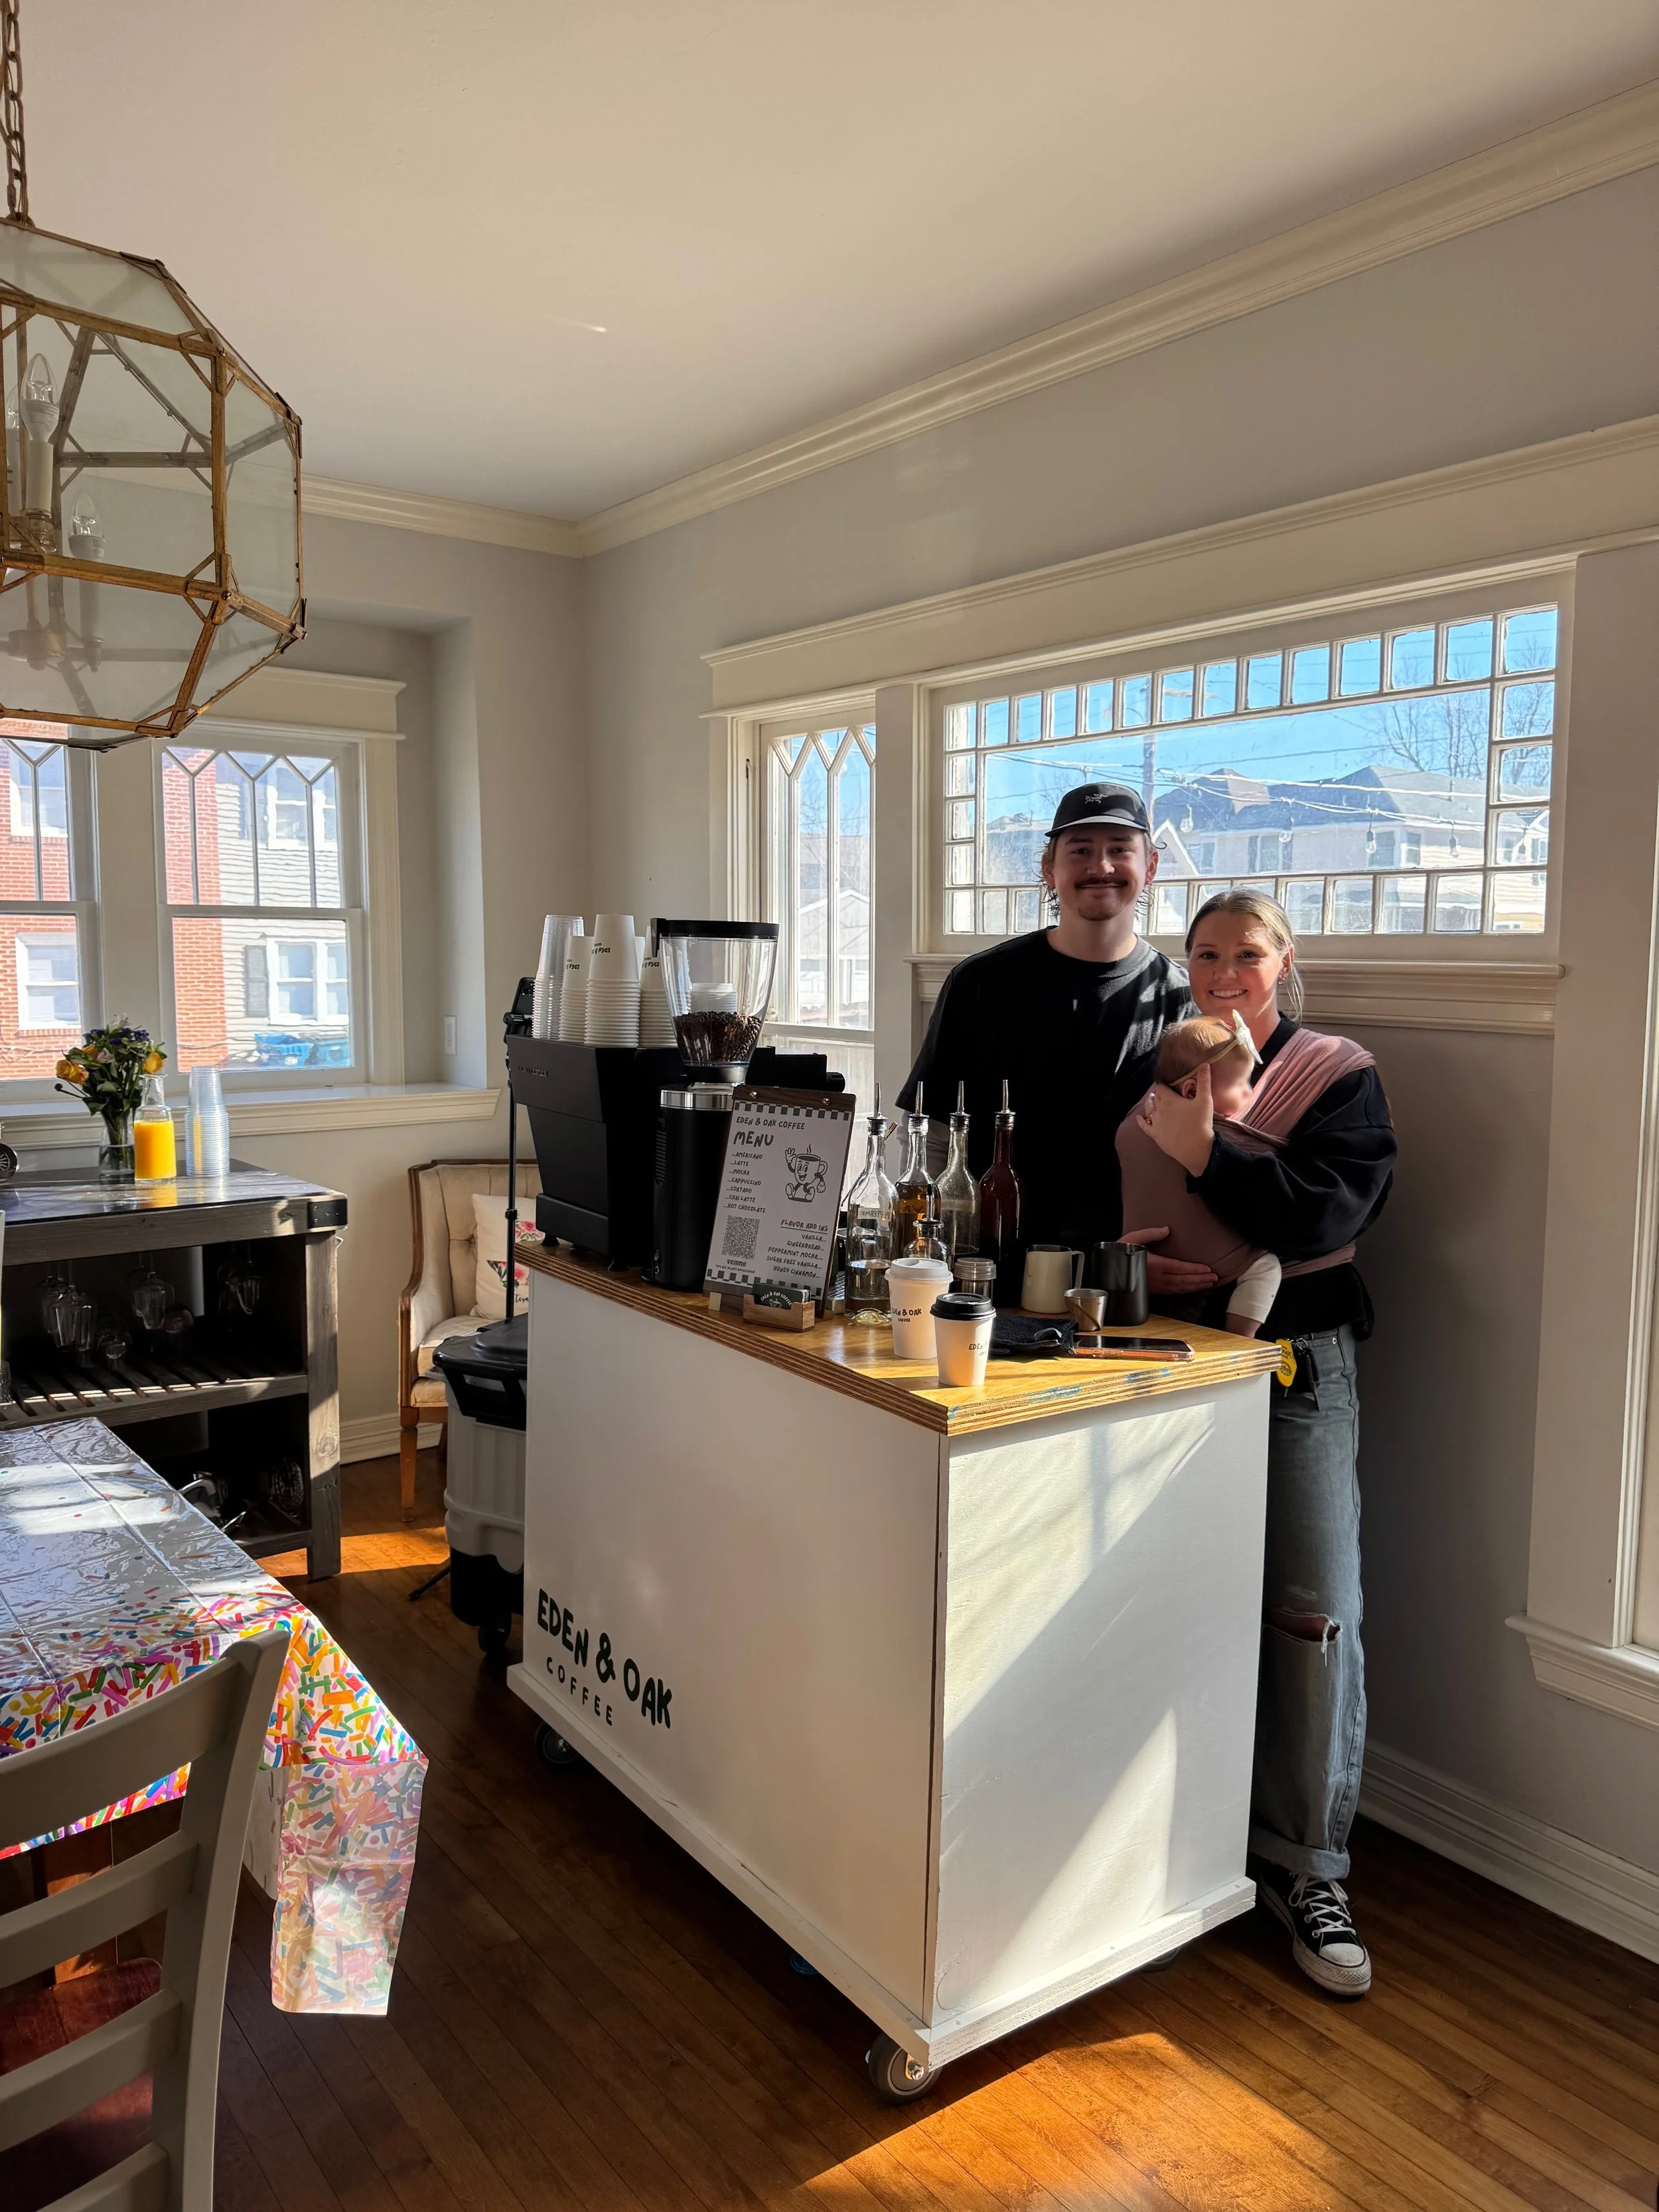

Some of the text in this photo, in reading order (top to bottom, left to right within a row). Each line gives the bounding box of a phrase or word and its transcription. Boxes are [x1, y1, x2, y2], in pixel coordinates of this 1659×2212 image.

[736, 1116, 753, 1126] EDEN
[778, 1121, 805, 1130] COFFEE
[733, 1131, 774, 1147] MENU
[738, 1205, 766, 1213] CHOCOLATE
[780, 1219, 804, 1228] FLAVOR
[768, 1246, 799, 1256] PEPPERMINT
[538, 1588, 672, 1729] EDEN & OAK
[547, 1657, 613, 1726] COFFEE
